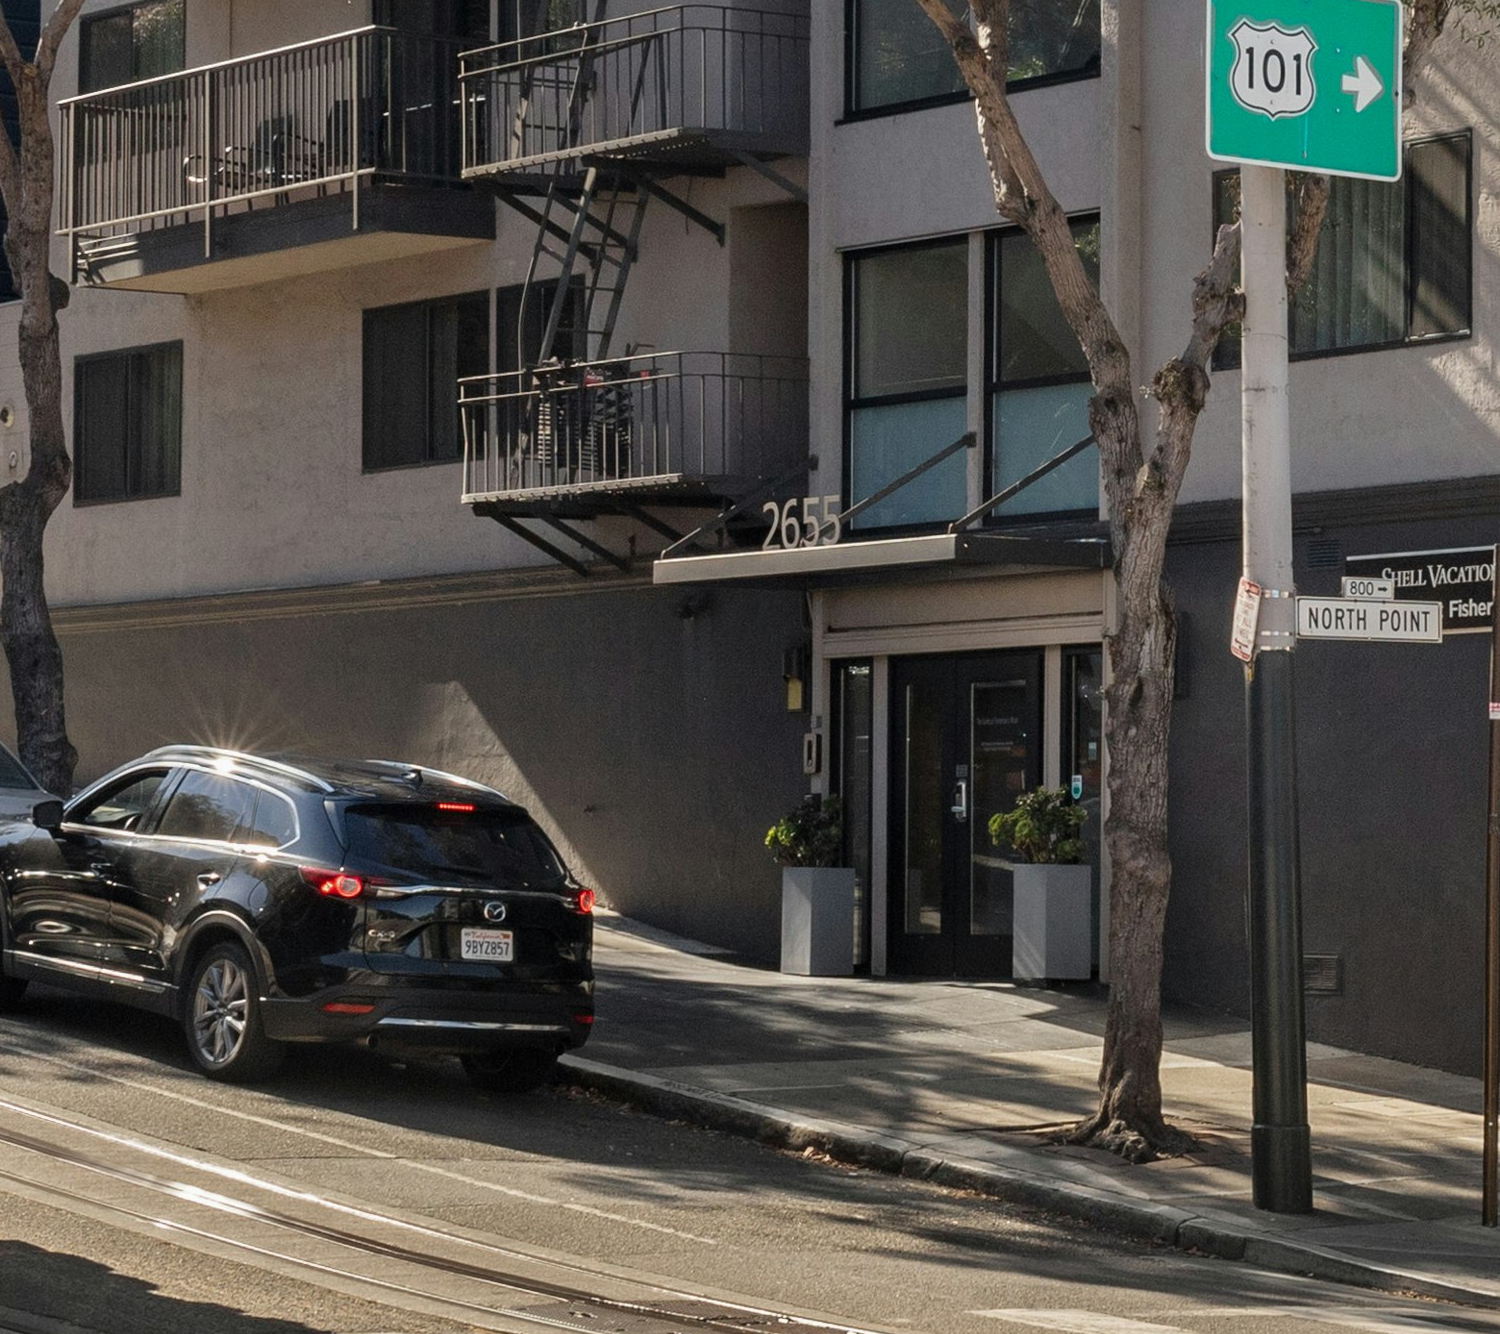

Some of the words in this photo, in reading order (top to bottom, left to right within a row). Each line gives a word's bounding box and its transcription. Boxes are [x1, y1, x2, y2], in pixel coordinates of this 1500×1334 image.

[1245, 46, 1301, 97] 101
[762, 495, 840, 551] 2655
[1382, 568, 1427, 587] SHELL
[1427, 564, 1495, 588] VACATIO
[1350, 581, 1374, 596] 800
[1449, 598, 1493, 618] Fisher
[1308, 607, 1367, 630] NORTH
[1380, 609, 1430, 632] POINT
[368, 929, 395, 938] CX-9
[465, 939, 509, 956] 9BYZ857
